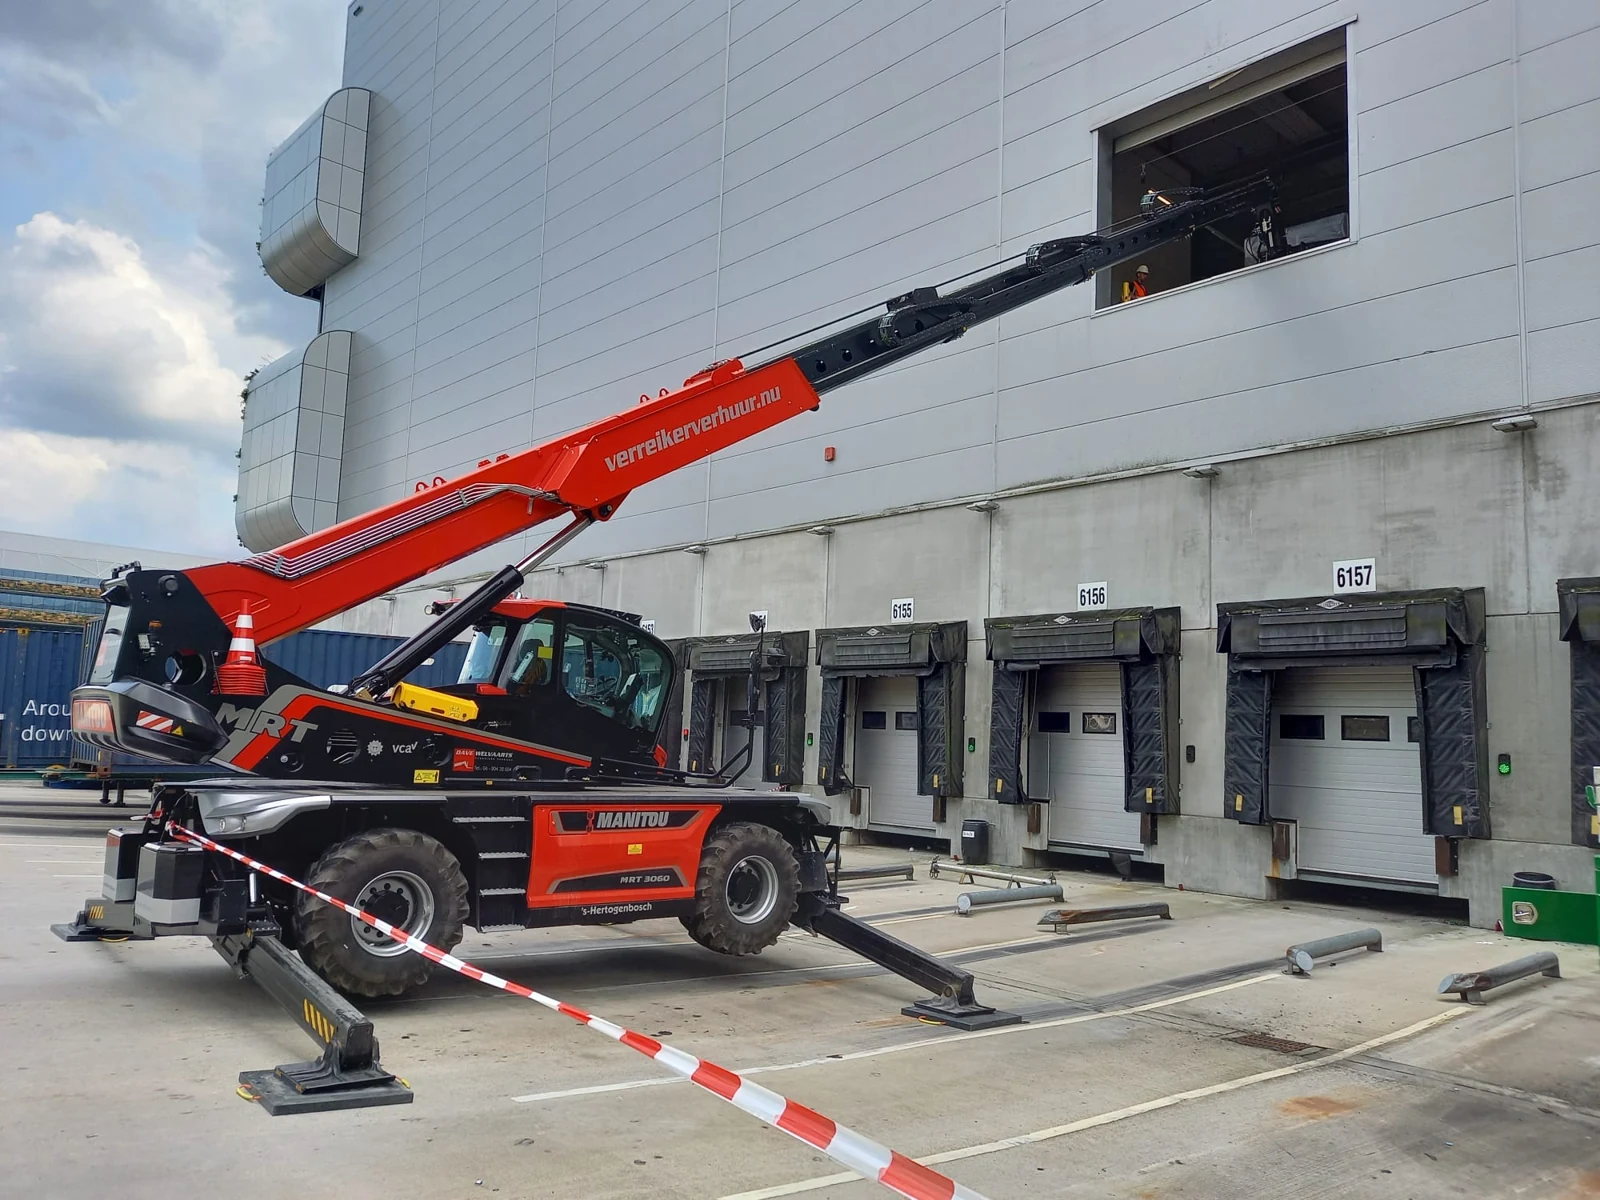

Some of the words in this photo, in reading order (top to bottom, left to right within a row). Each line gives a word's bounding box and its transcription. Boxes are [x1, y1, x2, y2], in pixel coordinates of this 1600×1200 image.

[604, 386, 782, 472] verreikerverhuur.nu
[1337, 565, 1372, 588] 6157
[1080, 587, 1105, 606] 6156
[893, 603, 912, 619] 6155
[214, 702, 319, 743] MRT
[597, 812, 669, 828] MANITOU
[620, 876, 642, 884] MRT
[644, 875, 671, 883] 3060
[581, 902, 653, 916] 's-Hertogenbosch
